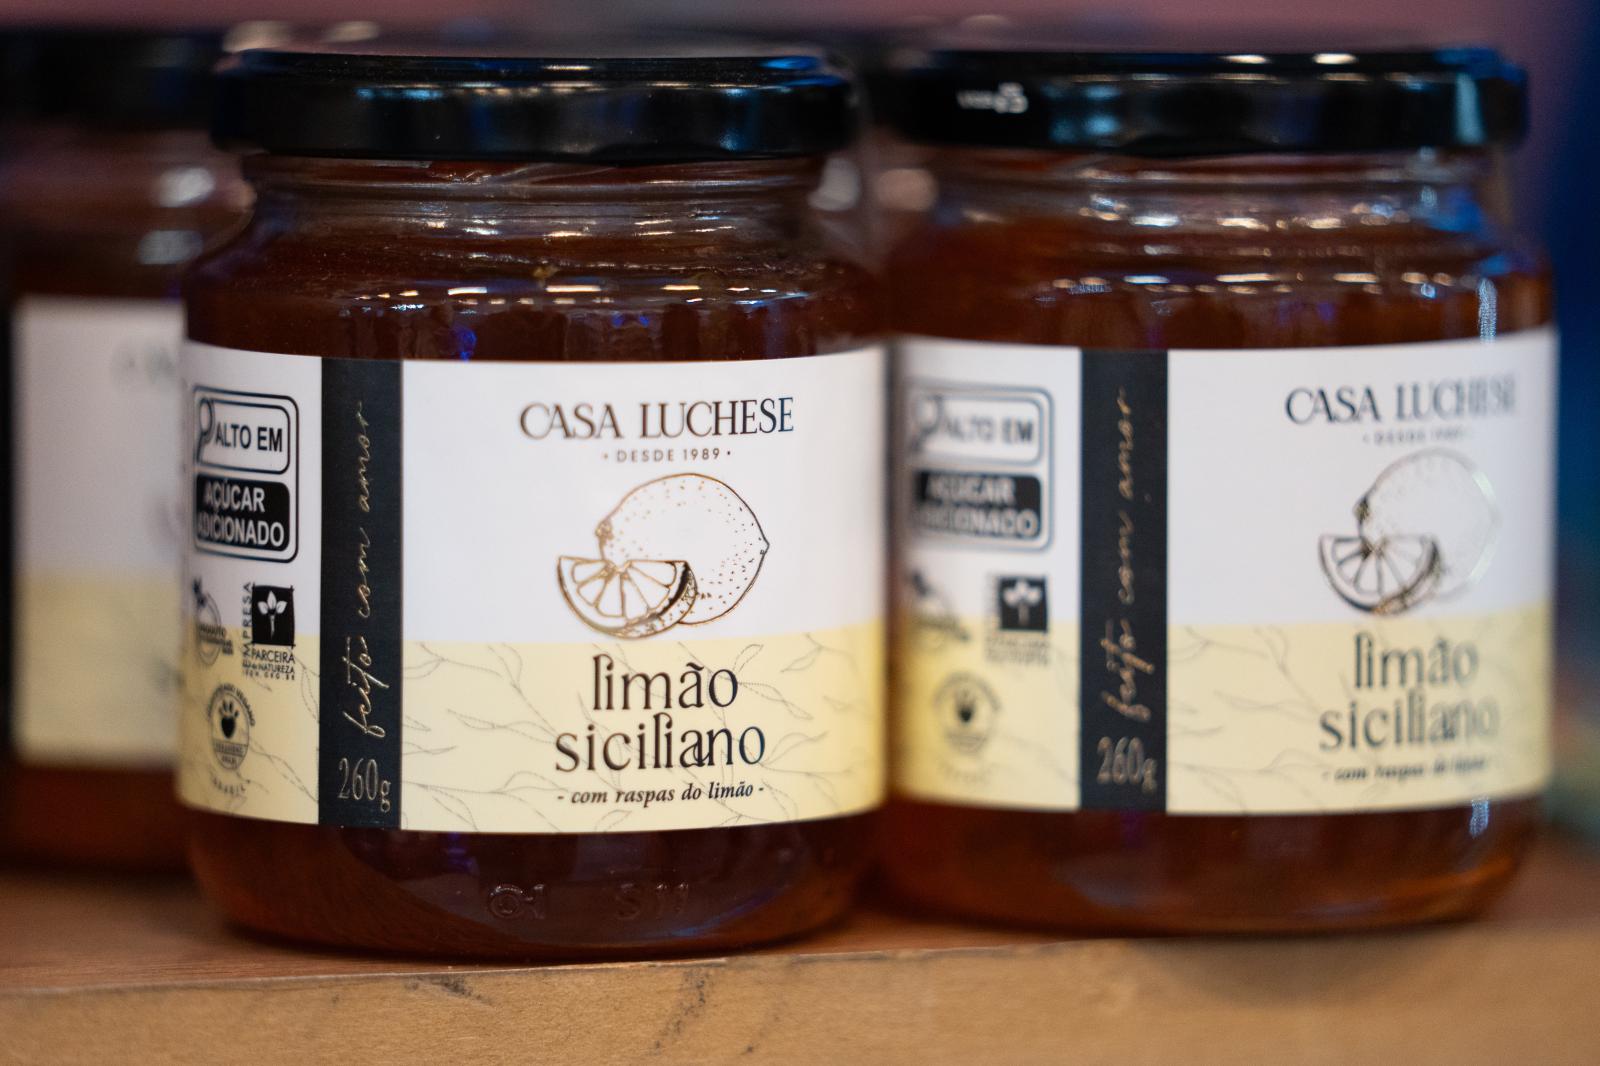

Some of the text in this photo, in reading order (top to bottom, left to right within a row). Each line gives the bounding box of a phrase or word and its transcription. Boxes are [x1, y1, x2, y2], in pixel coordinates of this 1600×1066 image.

[519, 397, 794, 440] CASA LUCHESE
[1284, 385, 1382, 424] CASA
[215, 421, 283, 452] ALTO EM
[617, 447, 720, 462] DESDE 1989
[203, 478, 266, 513] AÇÚCAR
[342, 401, 390, 738] feito com amor
[242, 582, 252, 669] EMPRESA
[252, 648, 296, 665] PARCEIRA
[1355, 630, 1479, 689] limão
[593, 653, 739, 711] limão
[555, 712, 766, 773] siciliano
[1317, 688, 1500, 752] siciliano
[338, 757, 391, 814] 260g
[571, 789, 608, 804] com
[615, 786, 676, 808] raspas
[681, 782, 702, 801] do
[708, 780, 754, 800] limão
